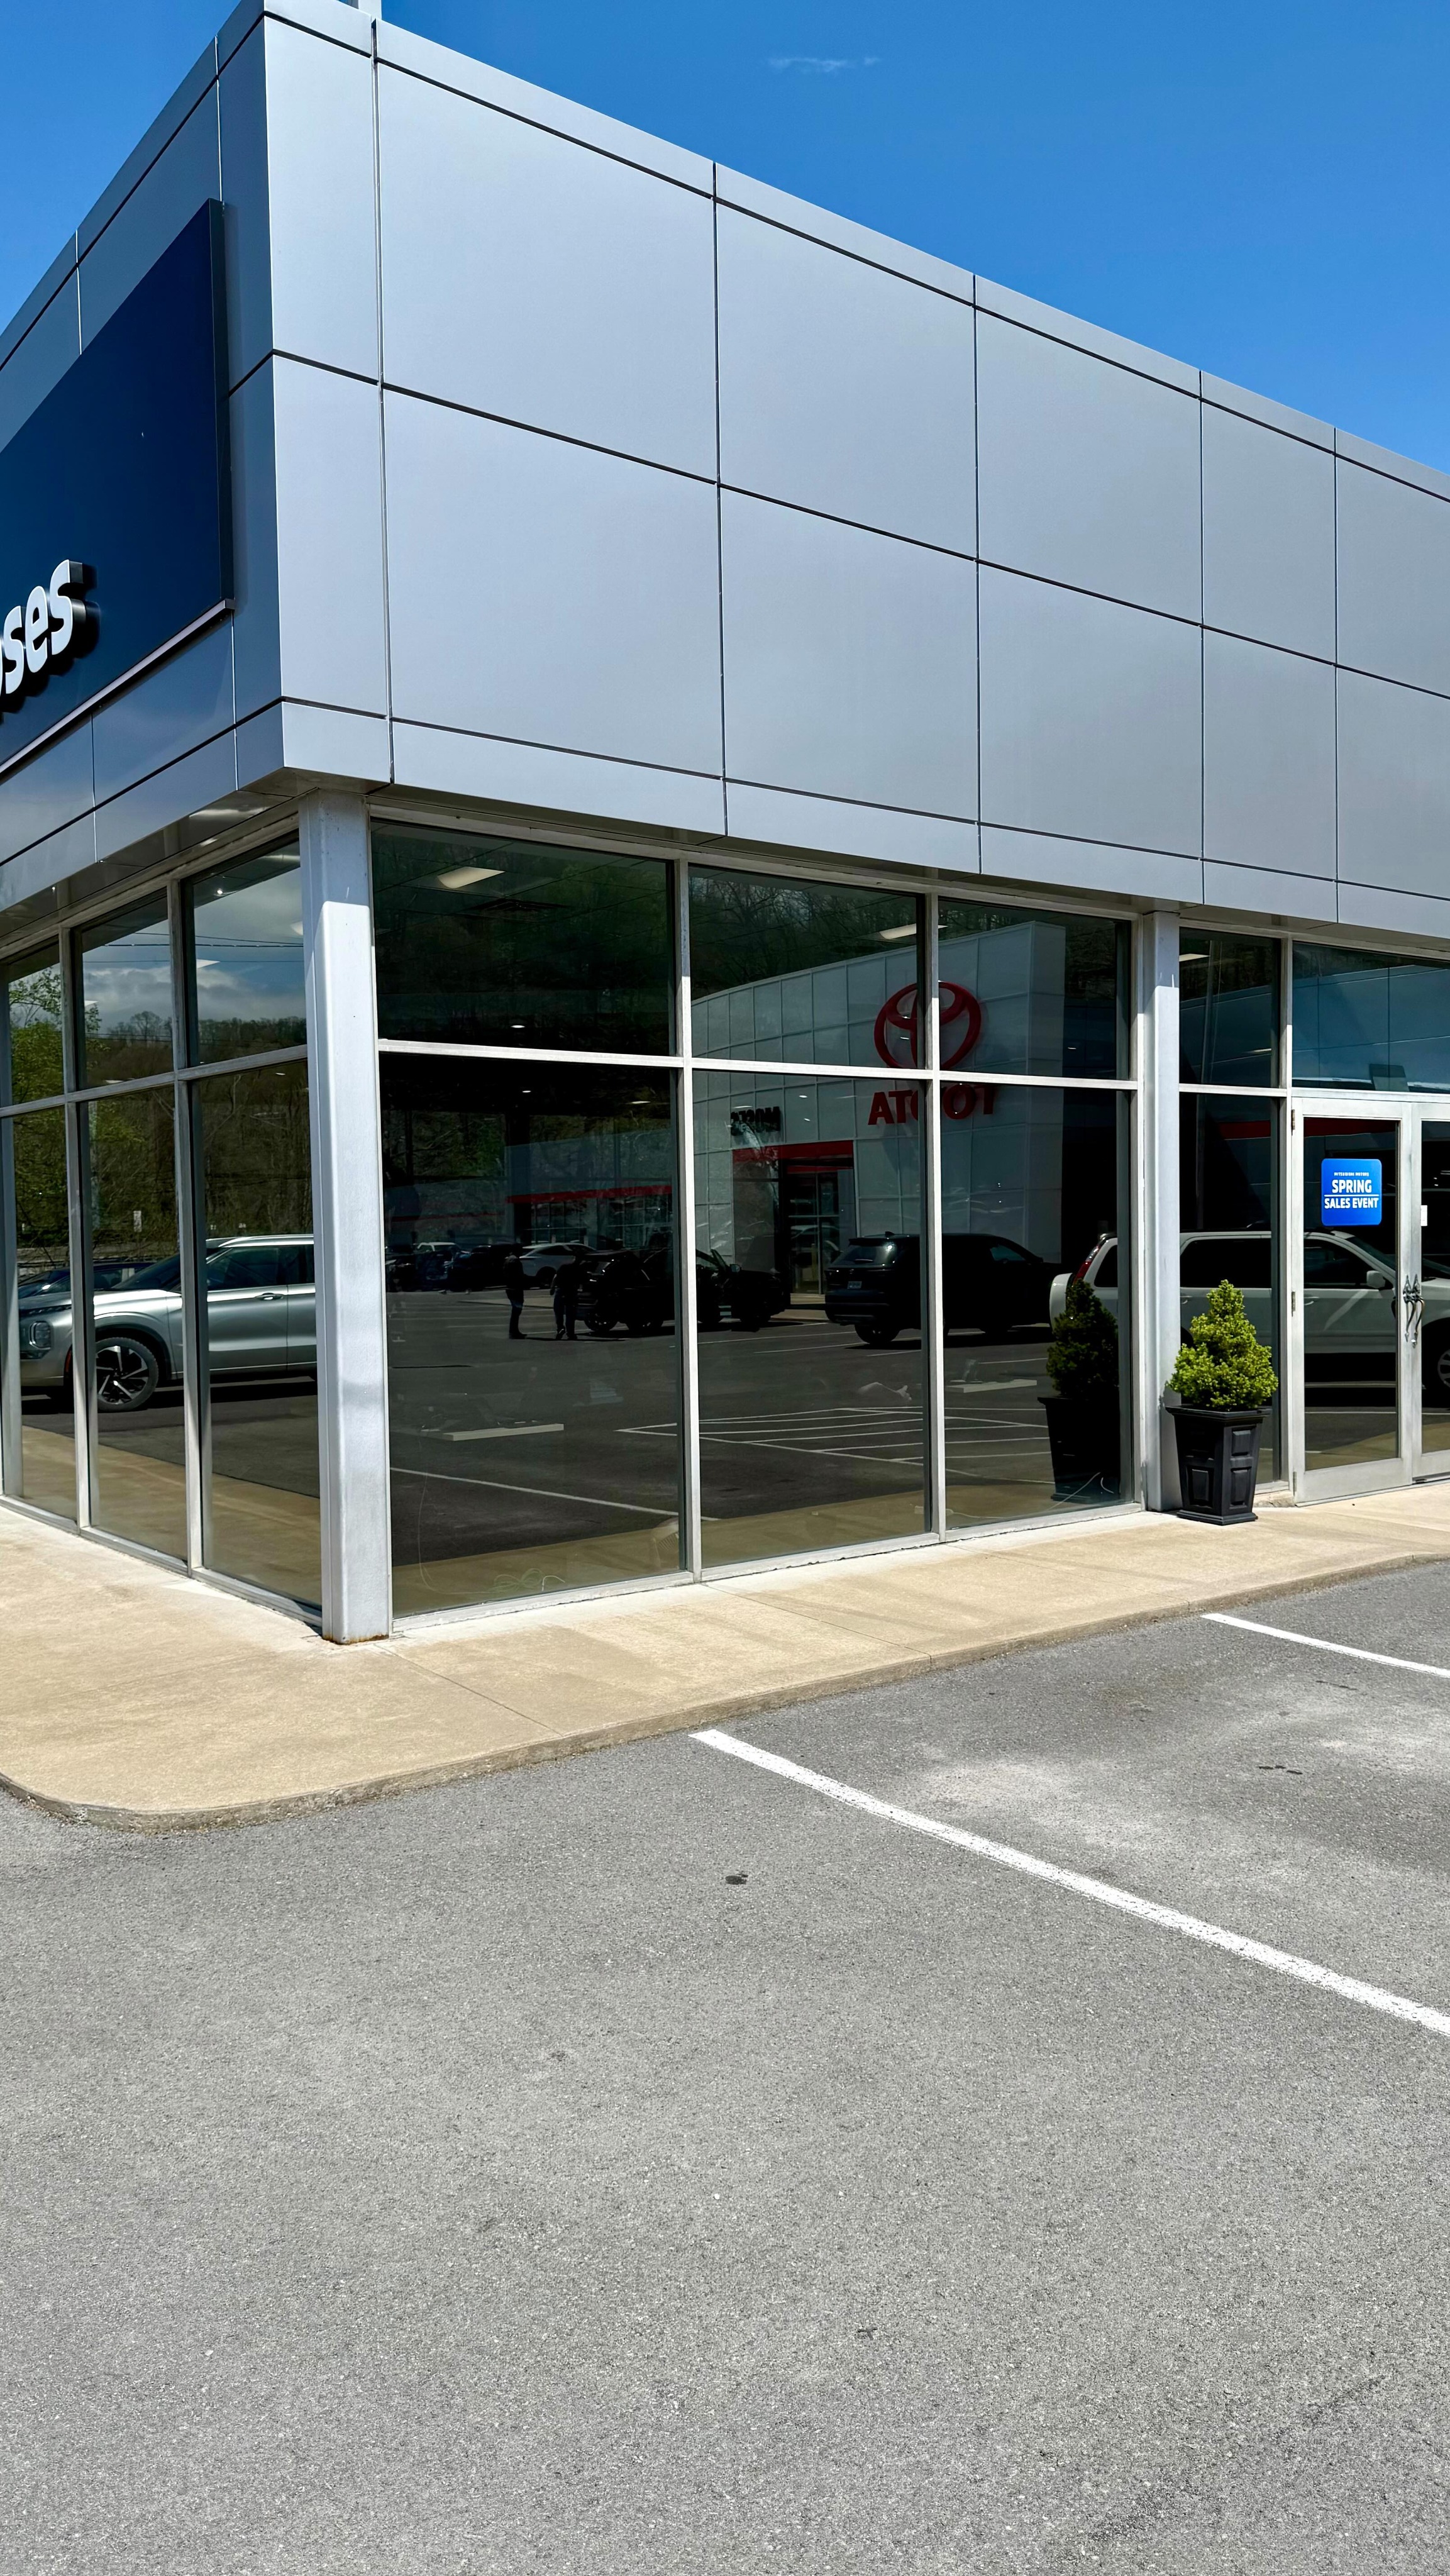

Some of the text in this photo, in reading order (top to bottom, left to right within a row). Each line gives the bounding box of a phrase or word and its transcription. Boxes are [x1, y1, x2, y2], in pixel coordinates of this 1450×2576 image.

[0, 559, 74, 695] ses
[1332, 1179, 1372, 1194] SPRING
[1324, 1197, 1379, 1209] SALES EVENT
